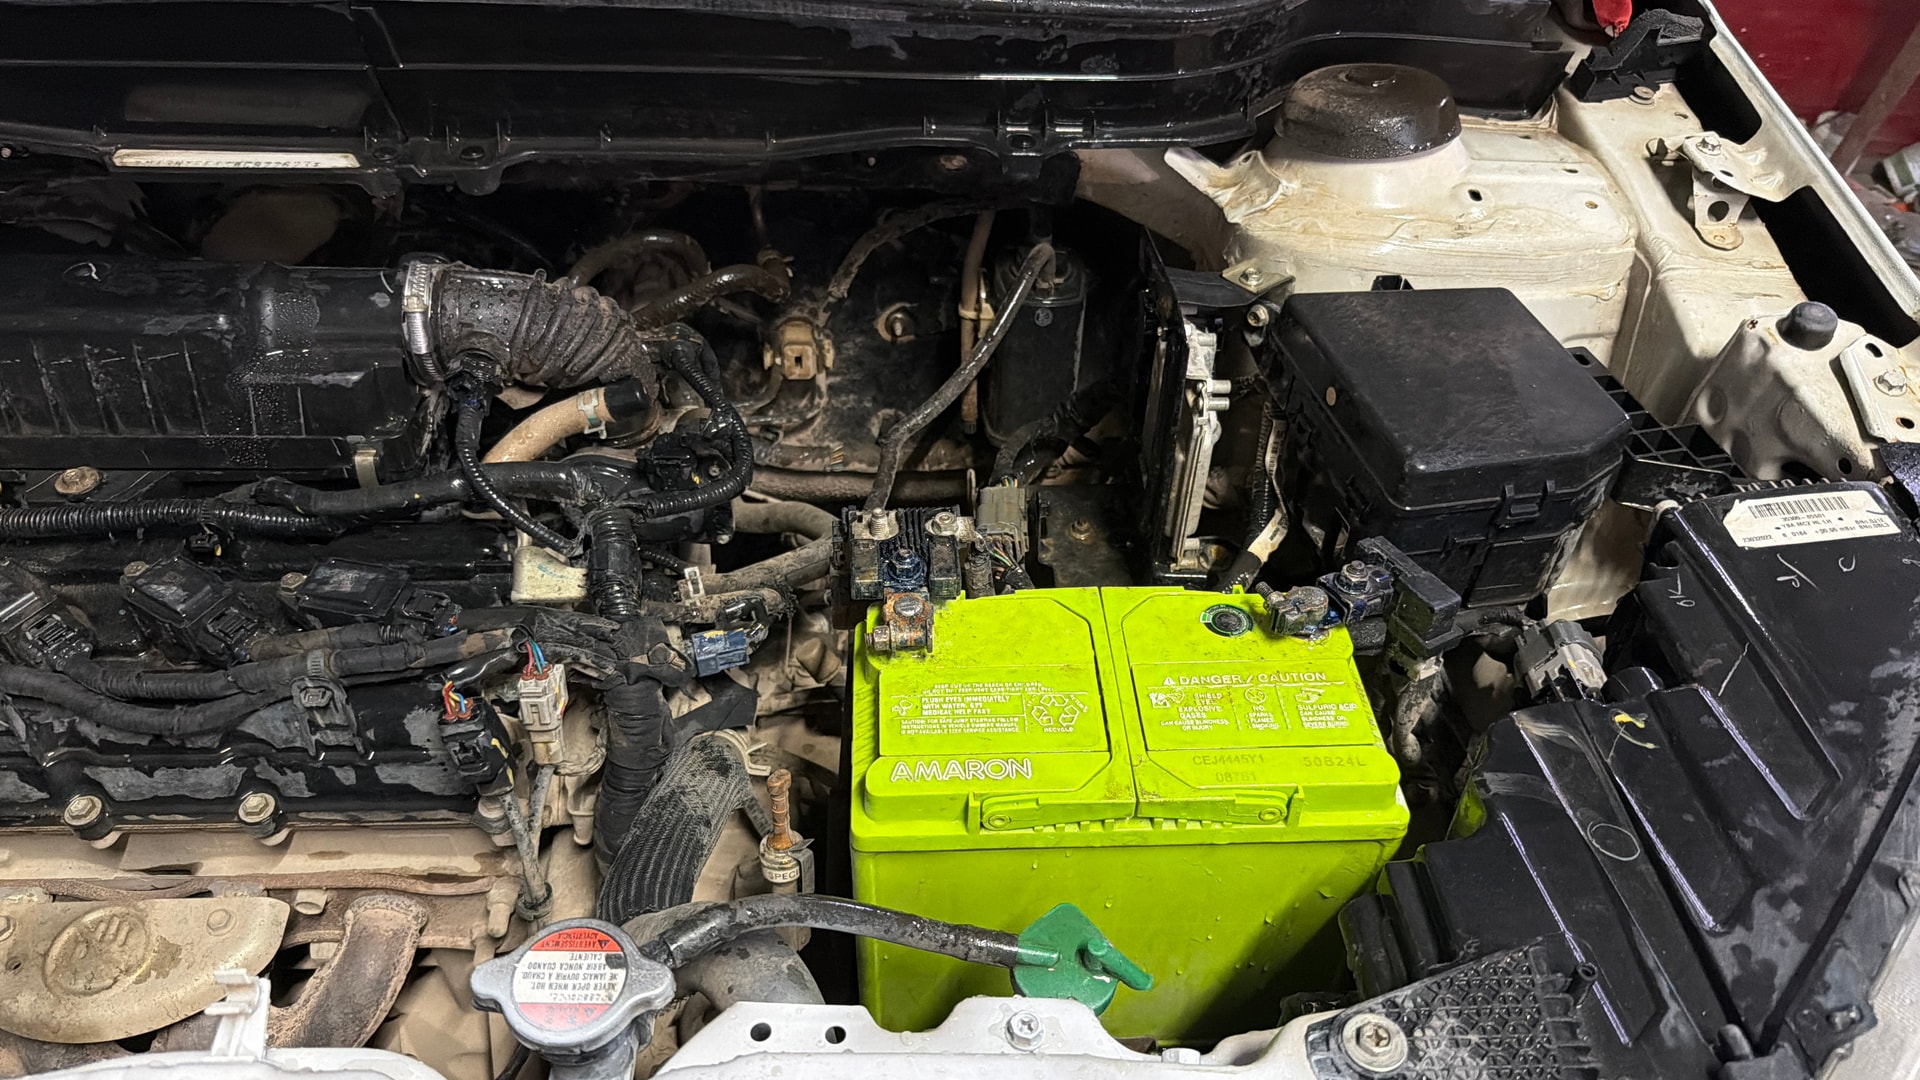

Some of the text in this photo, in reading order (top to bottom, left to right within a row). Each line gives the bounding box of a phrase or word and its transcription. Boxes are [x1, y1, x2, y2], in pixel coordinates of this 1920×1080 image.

[1179, 674, 1243, 685] DANGER
[1258, 672, 1326, 682] CAUTION
[1303, 756, 1367, 767] 50B24L
[890, 758, 1032, 782] AMARON
[541, 940, 597, 948] AVERTISSEMENT
[527, 962, 607, 971] ABRIR NUNCA CUANDO
[548, 982, 569, 991] WHEN
[572, 982, 590, 991] OPEN
[593, 982, 617, 991] NEVER
